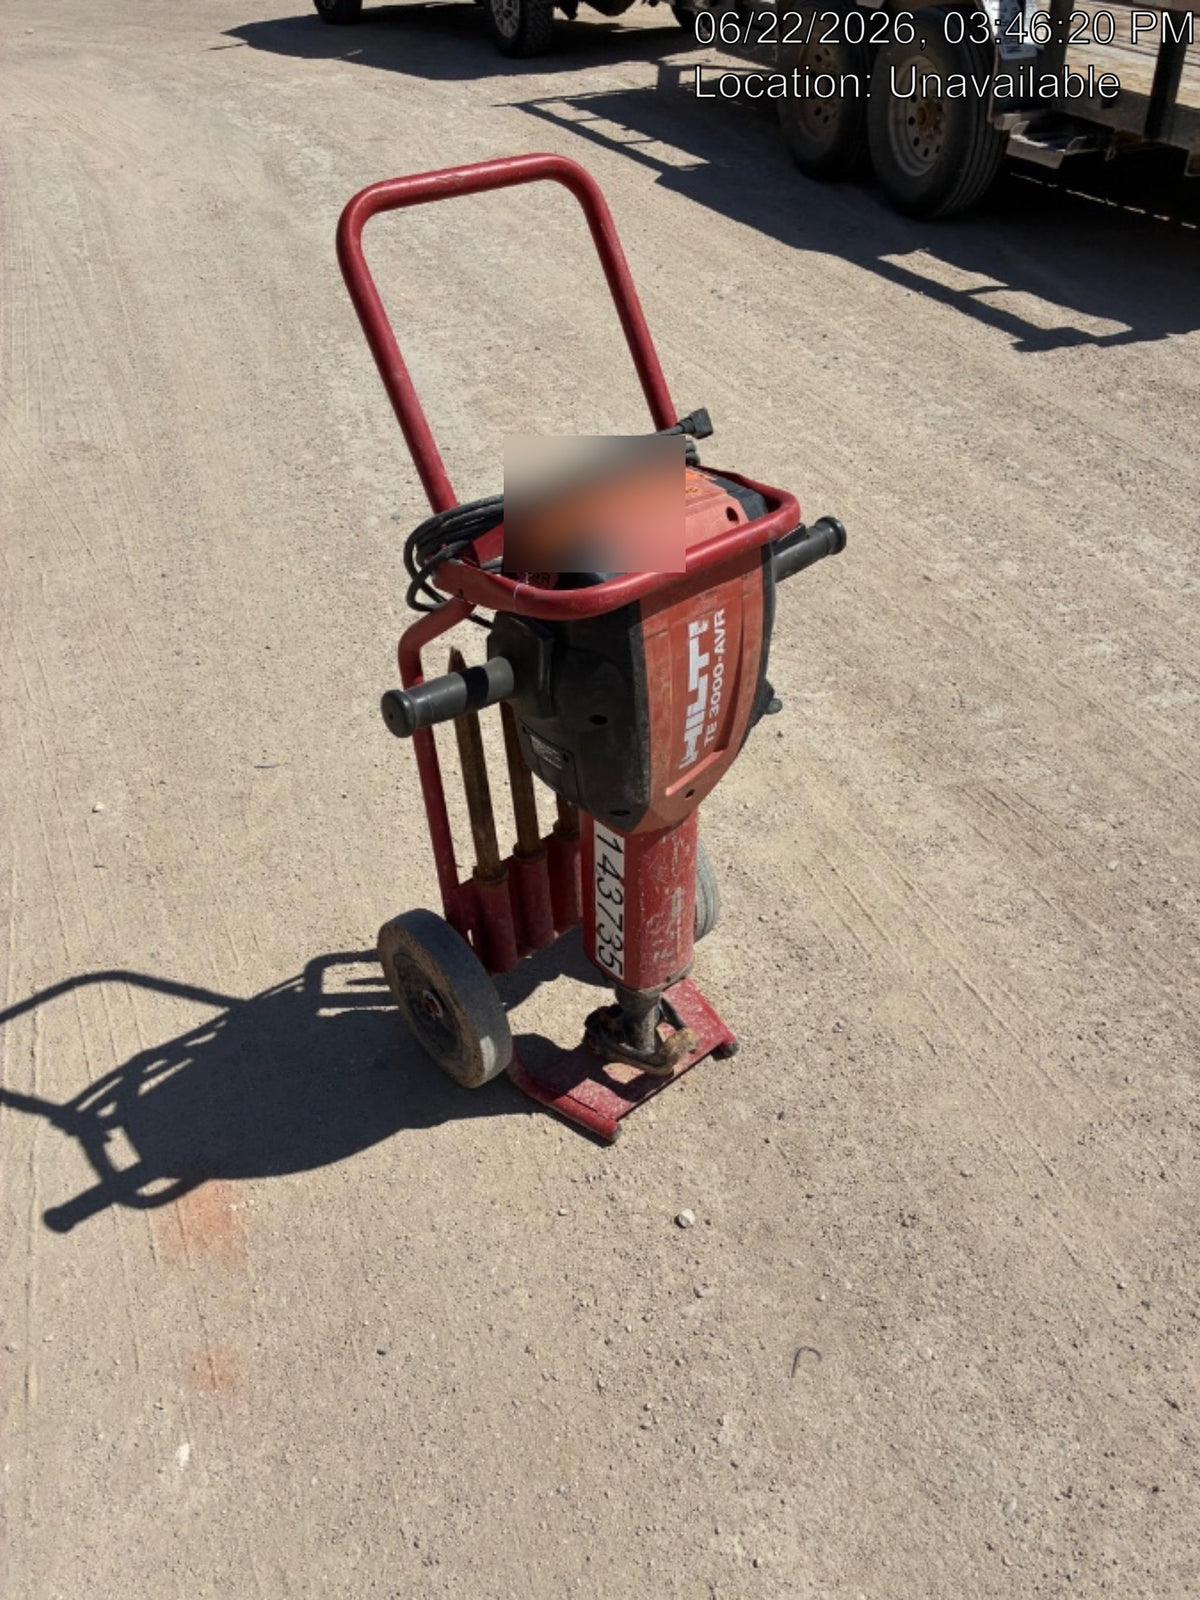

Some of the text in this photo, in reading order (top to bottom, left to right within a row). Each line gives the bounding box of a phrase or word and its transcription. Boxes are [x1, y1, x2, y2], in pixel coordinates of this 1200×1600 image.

[678, 620, 710, 769] HILTI
[704, 608, 726, 747] TE 3000-AVR
[596, 833, 624, 975] 143735
